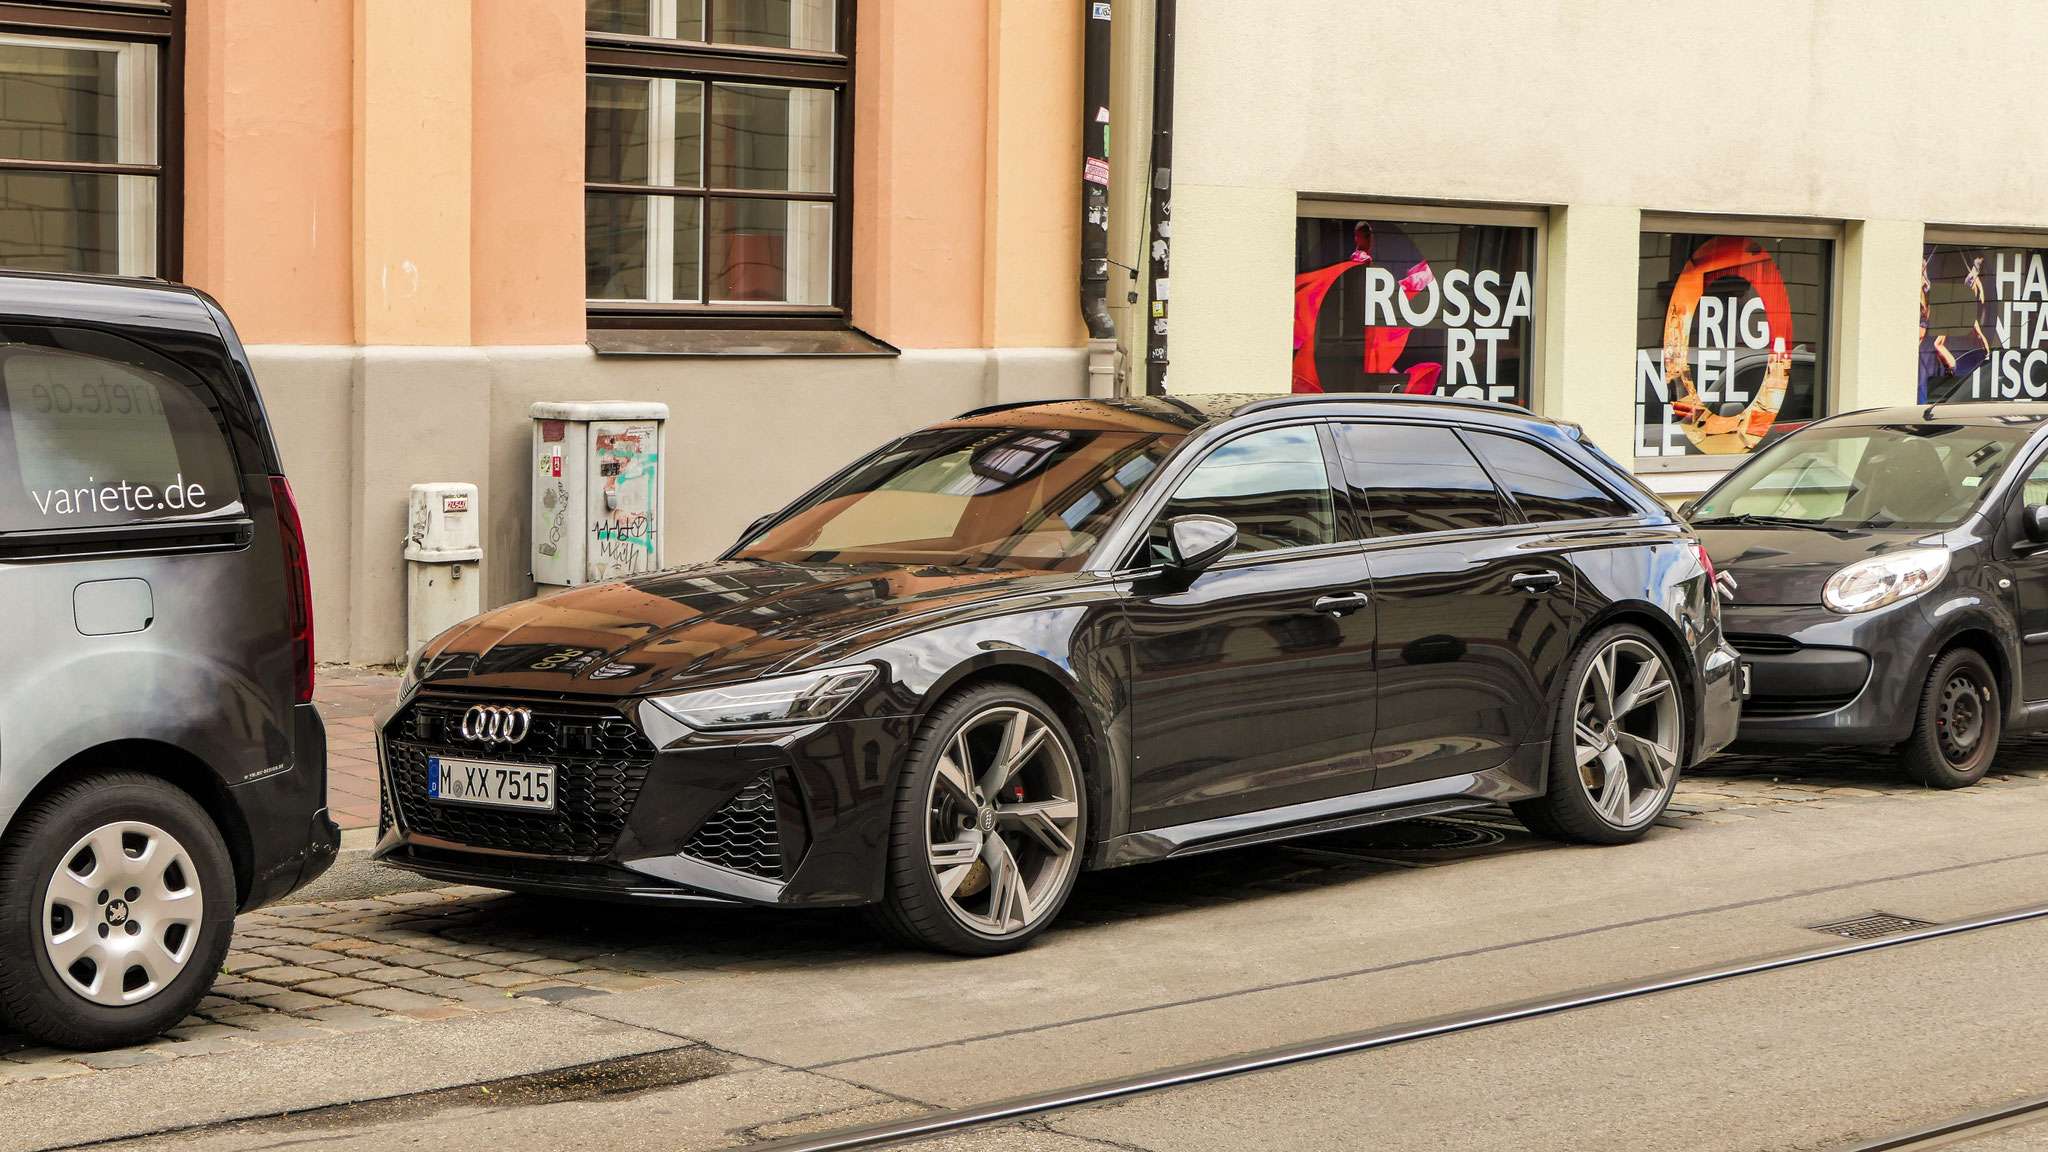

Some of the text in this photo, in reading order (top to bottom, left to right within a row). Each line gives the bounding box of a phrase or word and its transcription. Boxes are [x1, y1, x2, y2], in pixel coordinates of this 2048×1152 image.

[1364, 267, 1532, 328] ROSSA
[1698, 295, 1771, 350] RIG
[1446, 327, 1510, 385] RT
[1697, 350, 1749, 403] EL
[1635, 403, 1686, 457] LE
[32, 473, 207, 516] variete.de
[440, 764, 549, 802] M XX 7515
